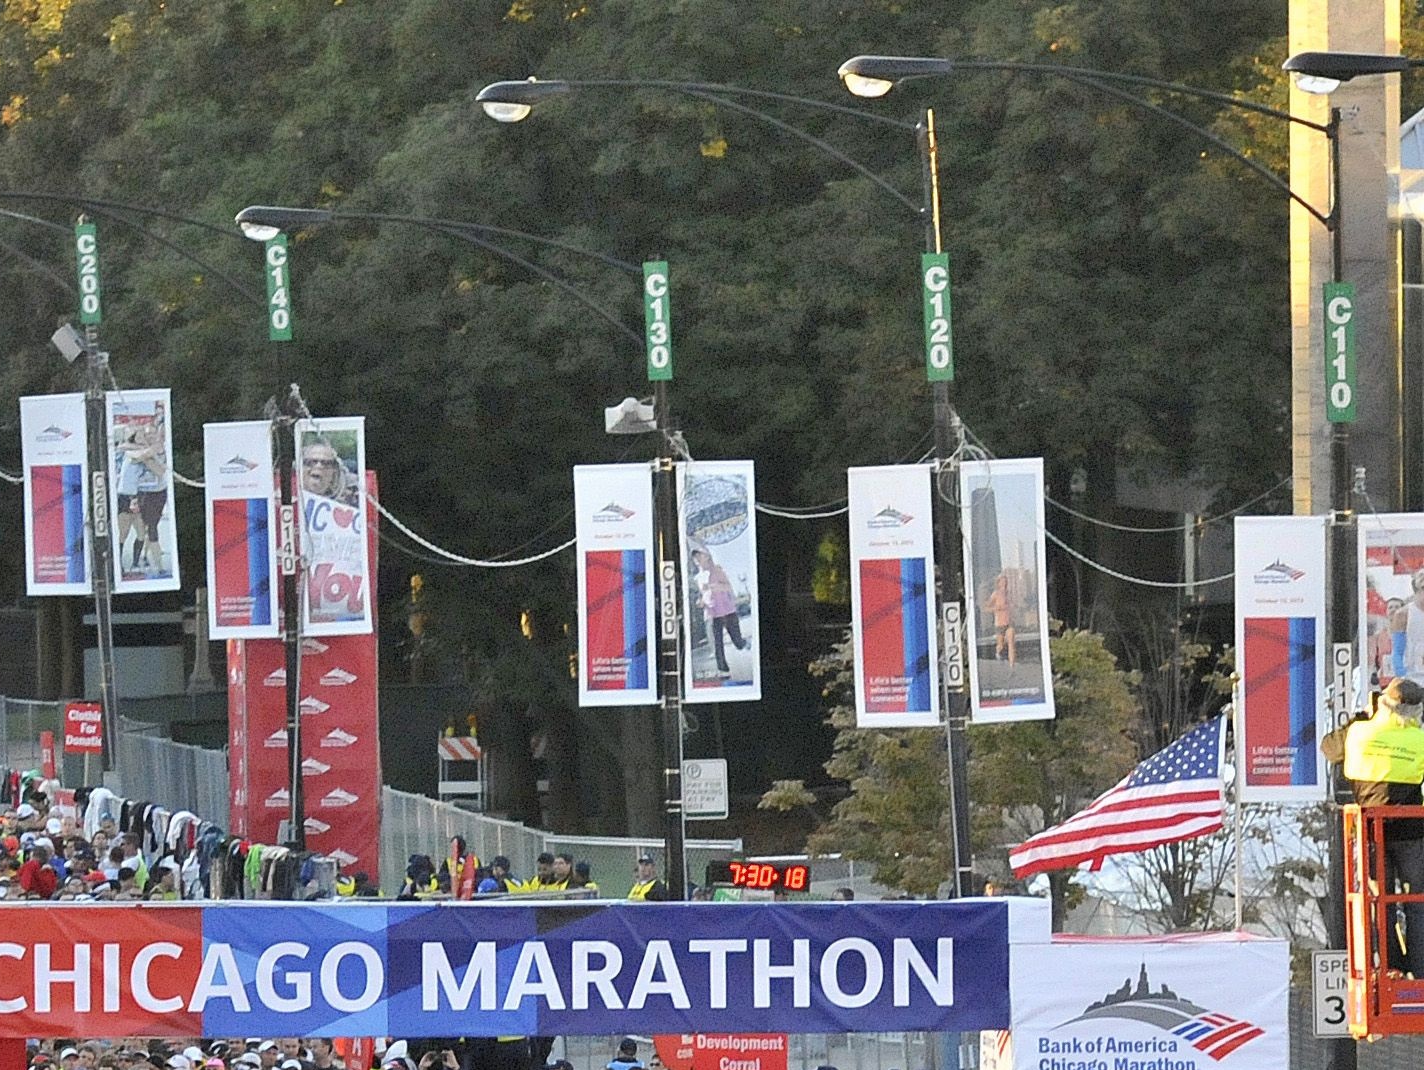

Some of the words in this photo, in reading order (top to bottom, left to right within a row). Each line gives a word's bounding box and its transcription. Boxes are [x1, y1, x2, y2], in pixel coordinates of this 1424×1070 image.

[77, 234, 99, 314] C200
[267, 245, 289, 329] C140
[645, 273, 669, 369] C130
[924, 265, 950, 369] C120
[1328, 296, 1352, 409] C110
[282, 508, 294, 572] C140
[663, 565, 675, 636] C130
[945, 606, 959, 681] C120
[1335, 649, 1350, 726] C110
[79, 723, 97, 734] For
[421, 937, 955, 1012] MARATHON
[696, 1034, 785, 1052] Development
[1038, 1037, 1084, 1053] Bank
[1085, 1037, 1104, 1053] of
[1105, 1036, 1178, 1053] America
